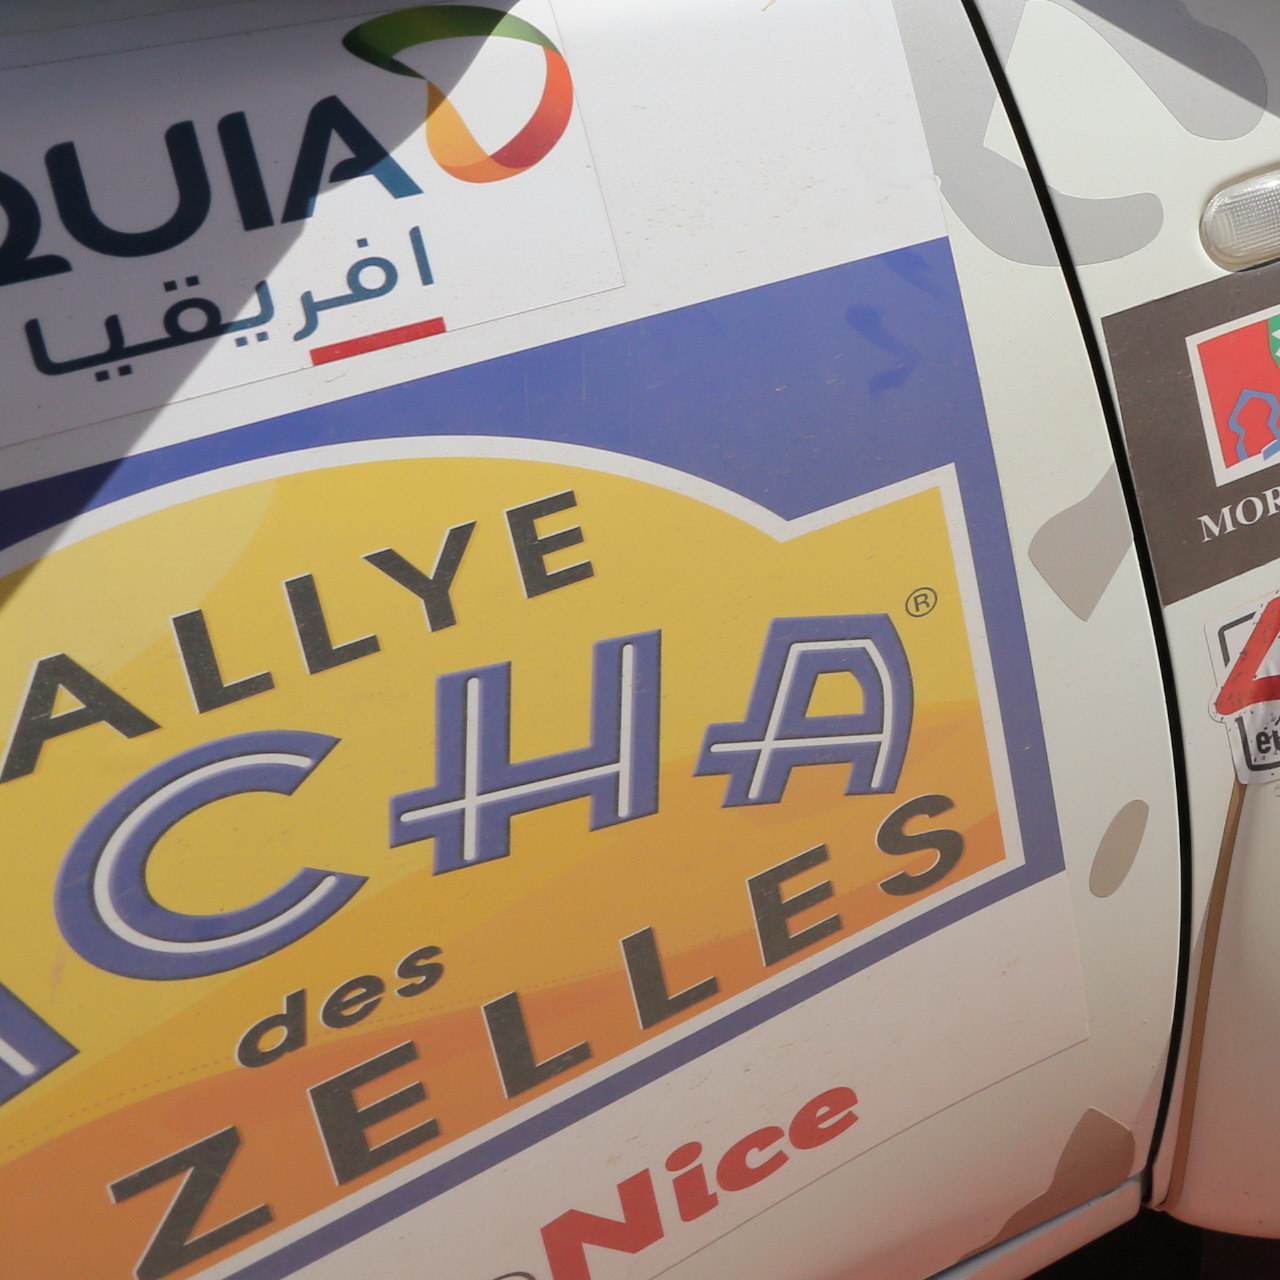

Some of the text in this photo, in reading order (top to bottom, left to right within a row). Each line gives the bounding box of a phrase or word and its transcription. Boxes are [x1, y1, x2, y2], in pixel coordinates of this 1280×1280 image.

[25, 225, 435, 382] افريقيا
[109, 793, 966, 1280] ZELLES
[234, 943, 444, 1069] des
[540, 1086, 859, 1280] Nice
